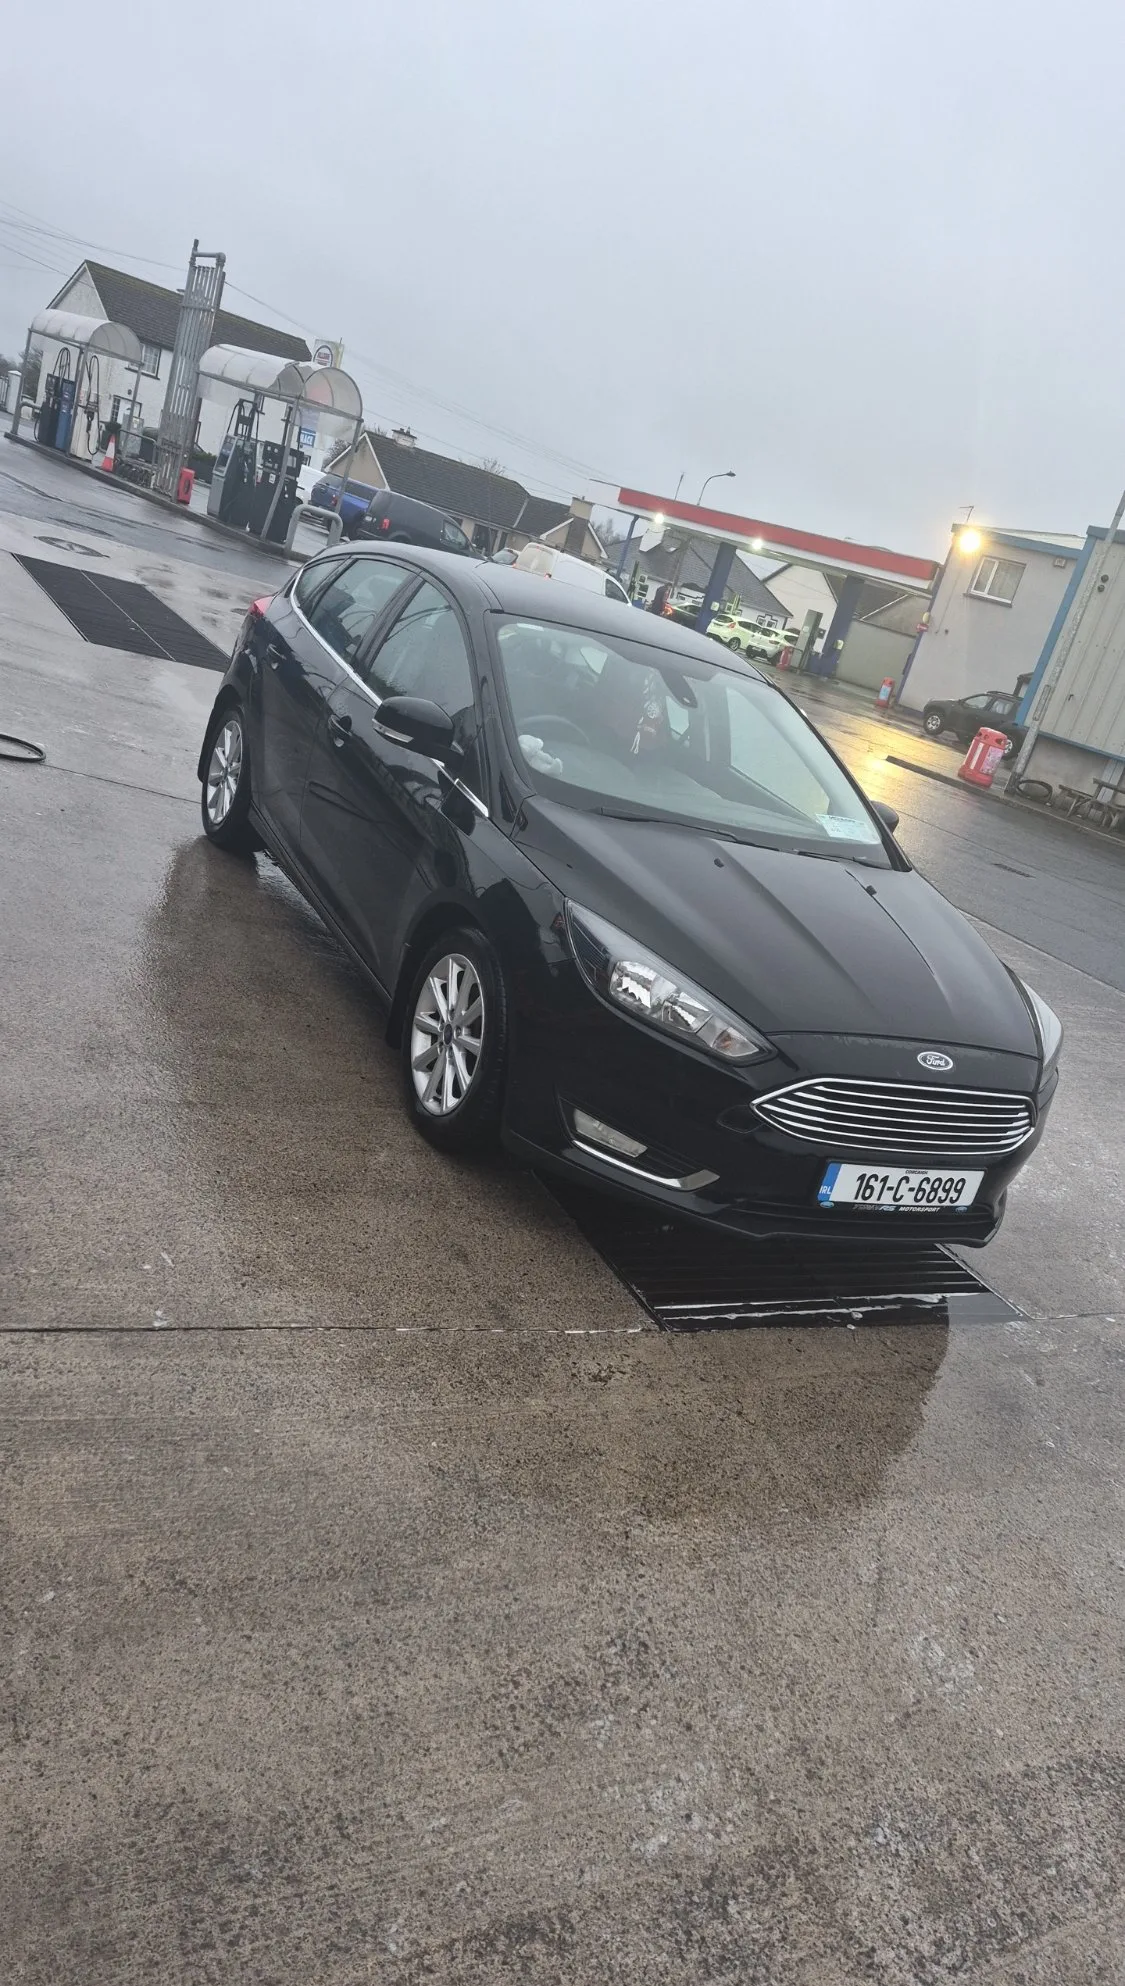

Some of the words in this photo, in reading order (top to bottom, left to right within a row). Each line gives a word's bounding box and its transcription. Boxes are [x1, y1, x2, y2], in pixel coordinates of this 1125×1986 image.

[926, 1055, 946, 1066] Ford
[818, 1185, 832, 1195] IRL
[854, 1173, 966, 1204] 161-C-6899
